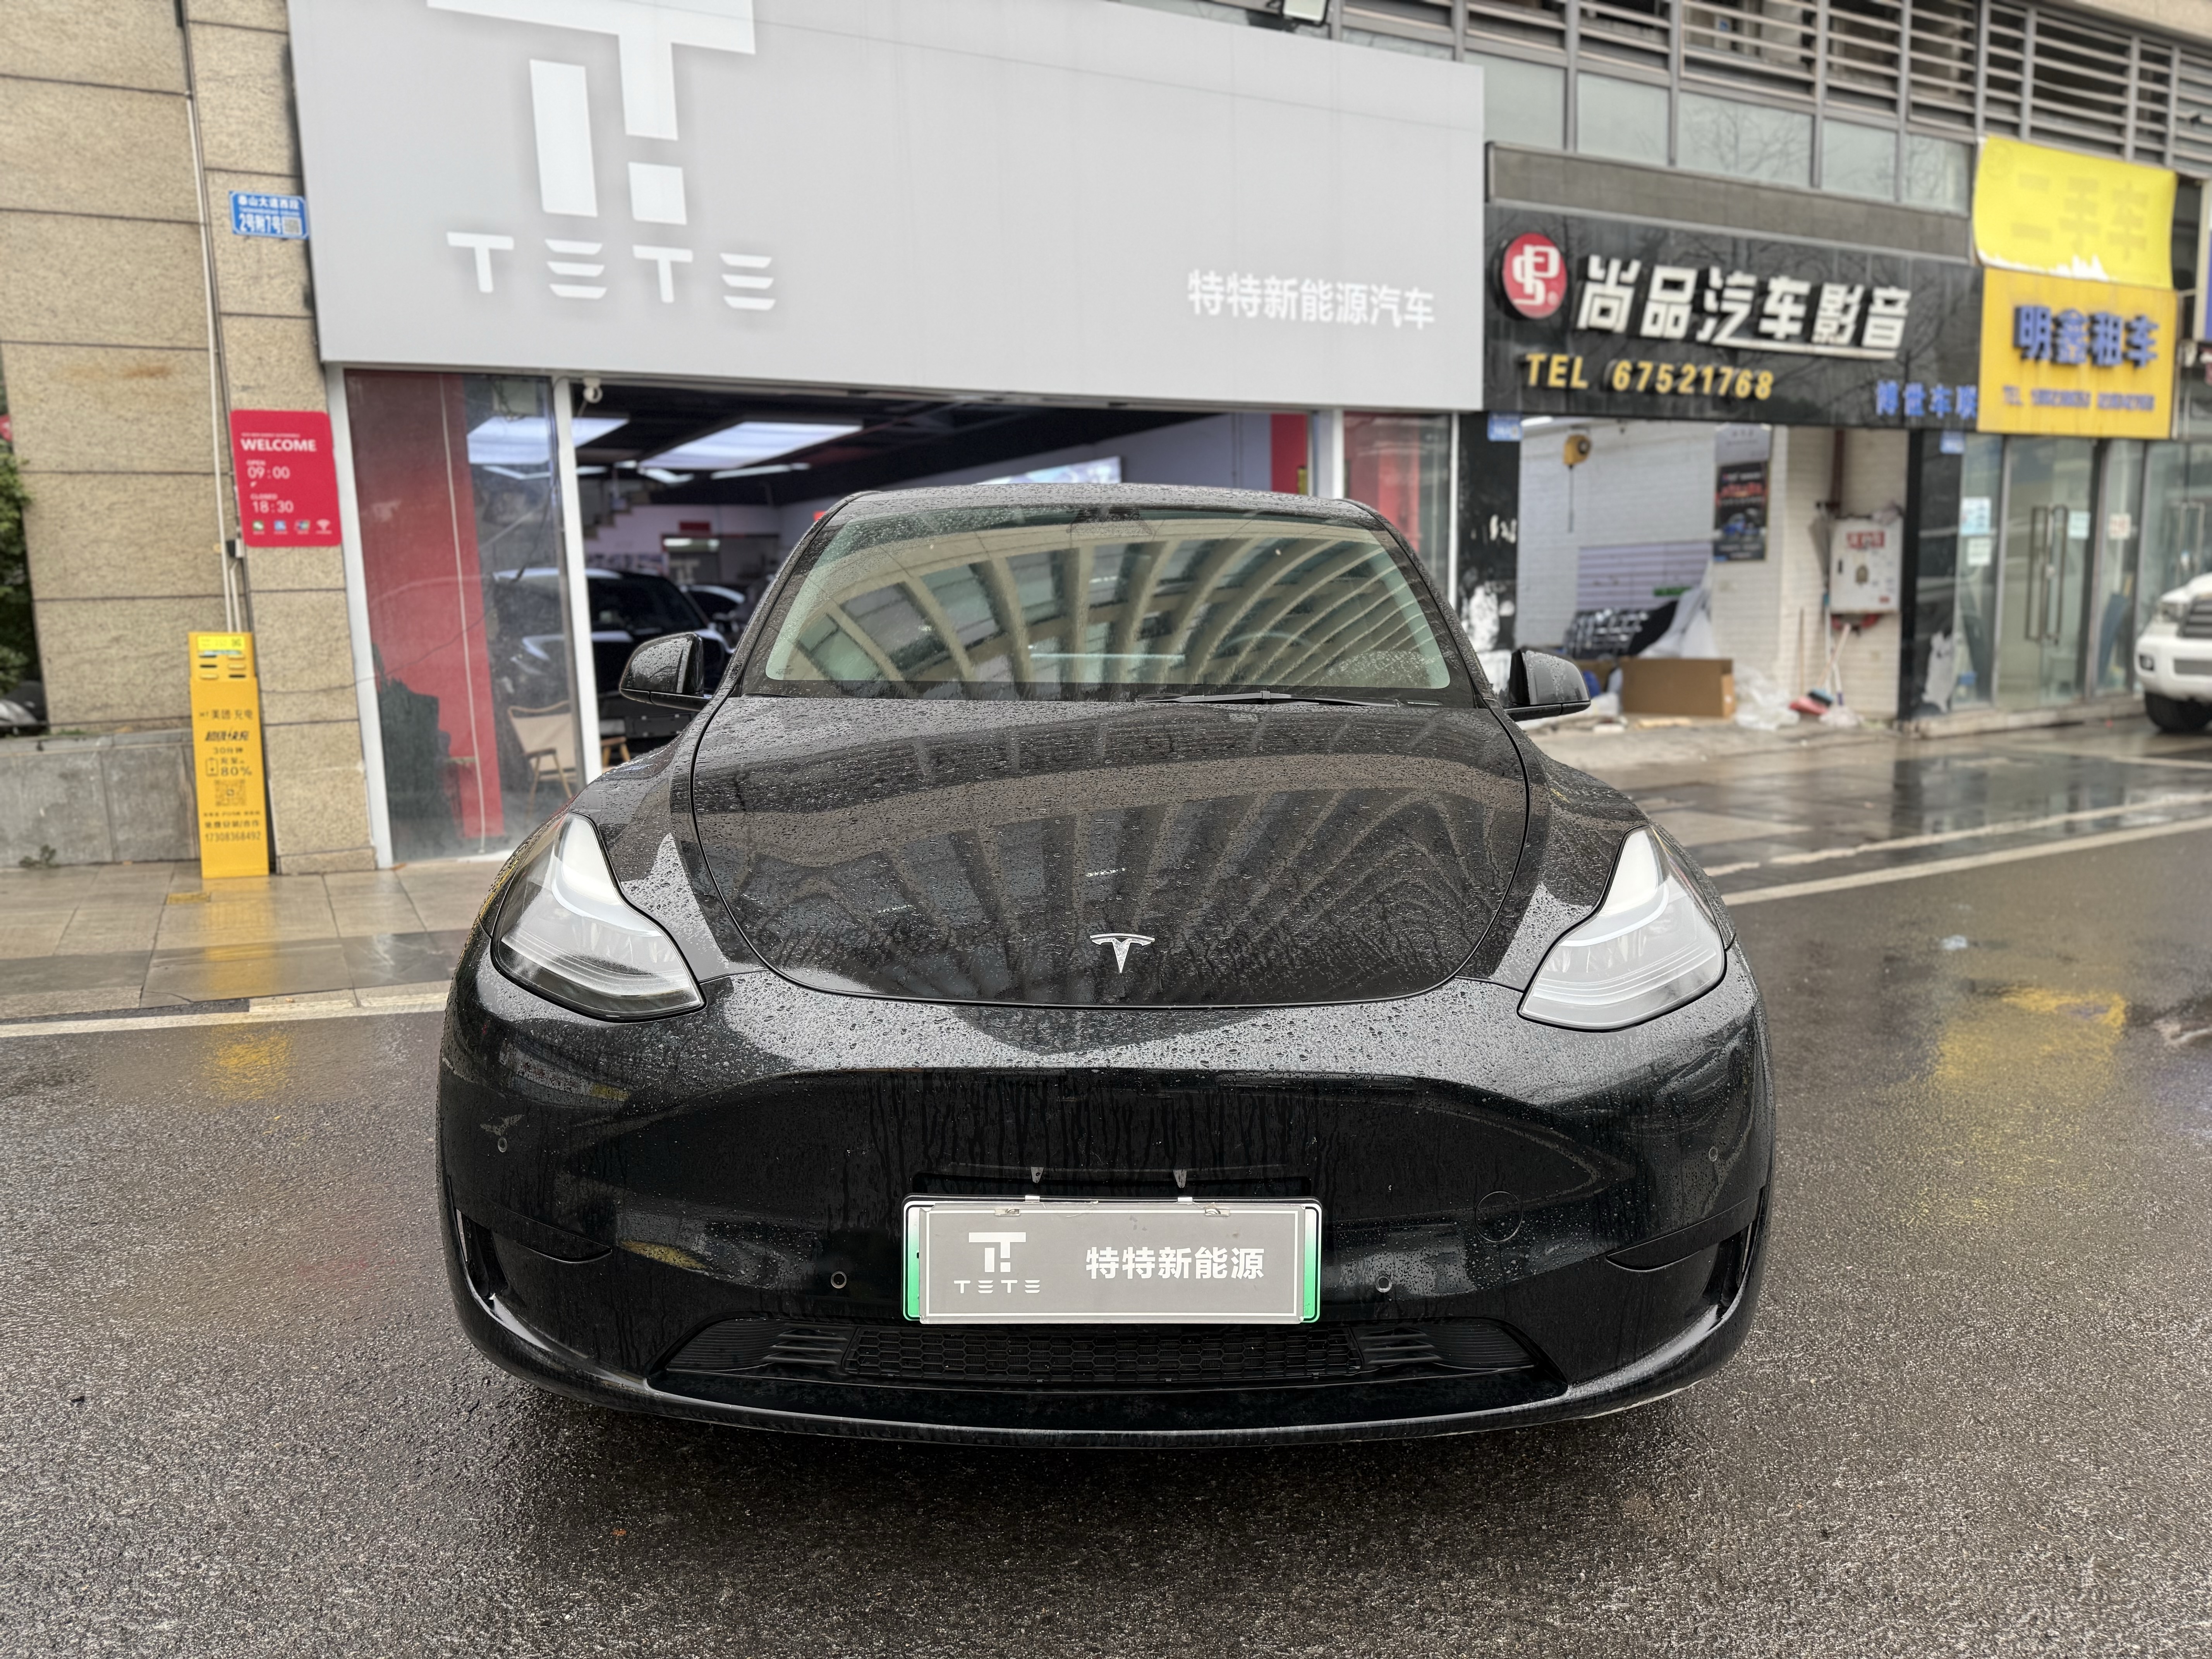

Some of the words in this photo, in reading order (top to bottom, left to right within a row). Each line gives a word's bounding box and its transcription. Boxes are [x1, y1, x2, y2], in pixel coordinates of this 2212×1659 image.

[447, 231, 775, 310] TETE
[1187, 268, 1435, 330] 特特新能源汽车
[1577, 254, 1911, 359] 尚品汽车影音
[2017, 305, 2158, 367] 明鑫租车
[1526, 353, 1589, 389] TEL
[1612, 360, 1774, 400] 67521768
[240, 438, 317, 452] WELCOME
[954, 1280, 1040, 1294] TETE
[1086, 1247, 1265, 1279] 特特新能源
